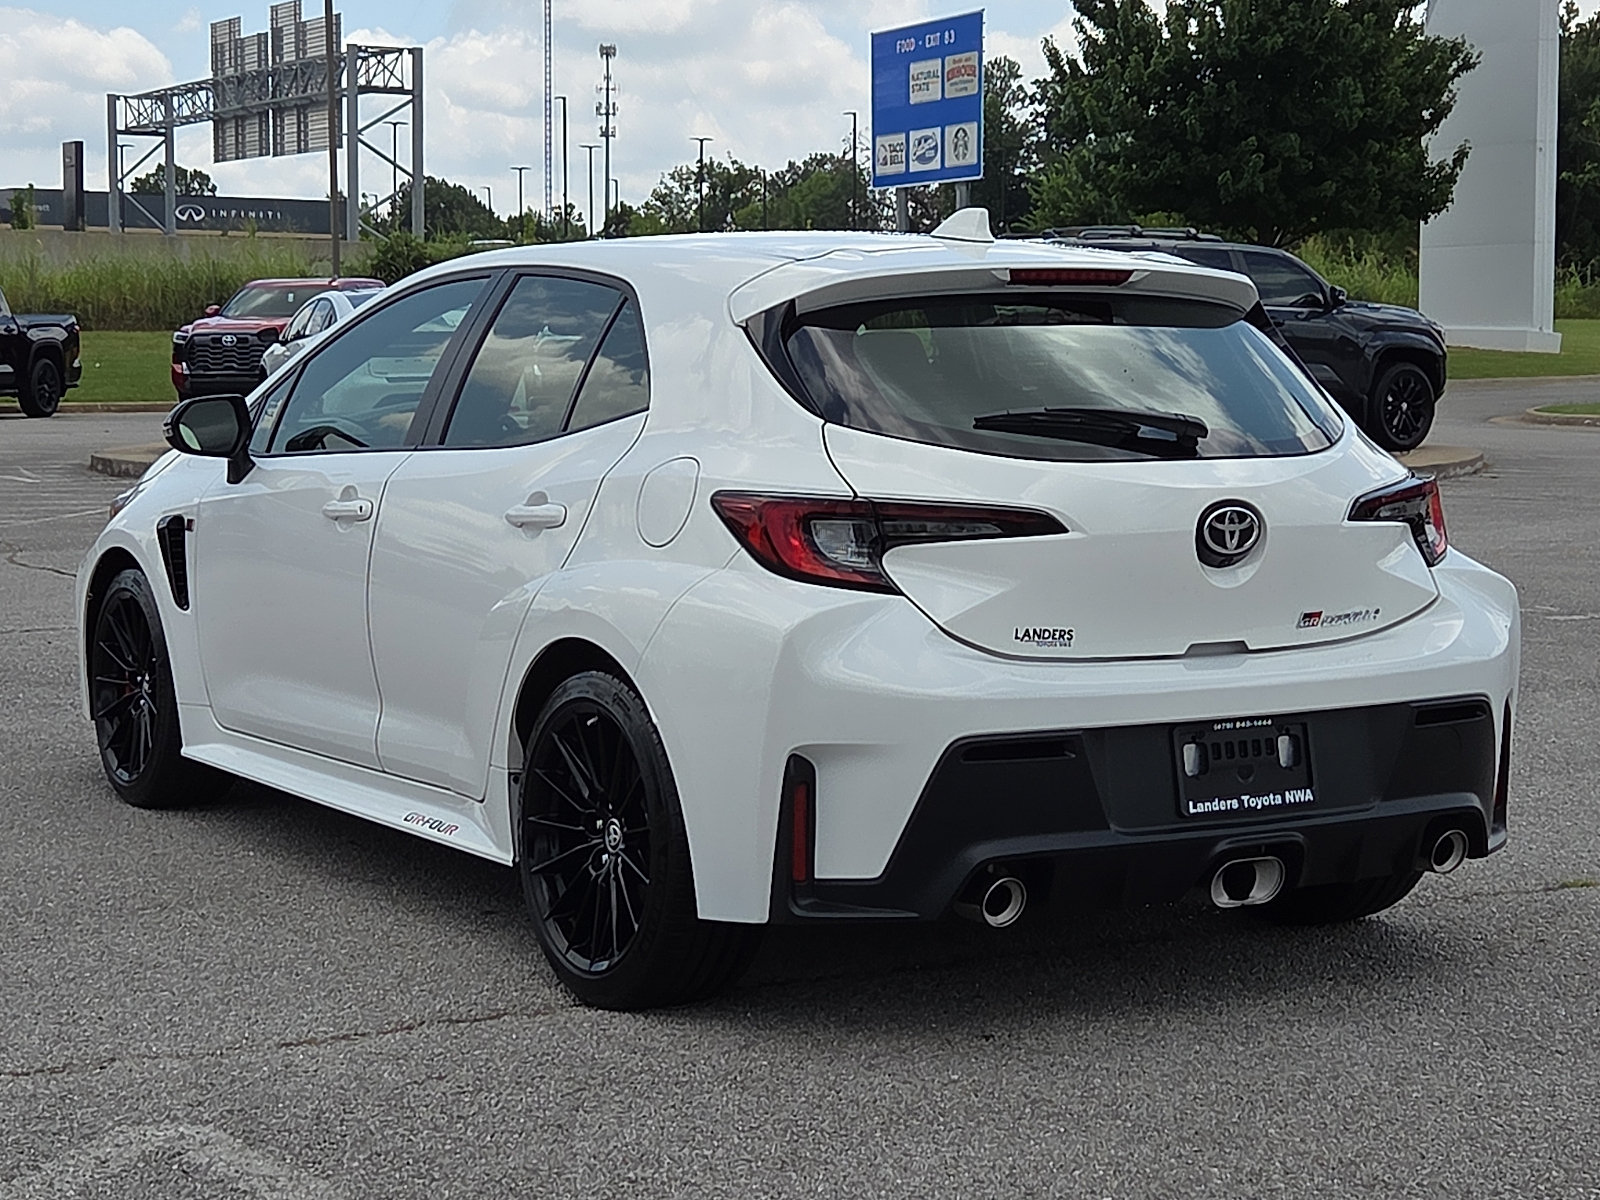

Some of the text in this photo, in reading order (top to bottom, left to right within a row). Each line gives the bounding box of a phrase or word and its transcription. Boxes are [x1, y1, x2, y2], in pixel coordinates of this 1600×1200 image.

[896, 37, 916, 54] FOOD
[925, 32, 941, 48] EXIT
[911, 69, 940, 82] NATURAL
[911, 82, 930, 94] STATE
[888, 141, 904, 153] TACO
[889, 153, 904, 166] BELL
[211, 208, 281, 220] INFINITI
[1014, 627, 1074, 643] LANDERS
[1188, 788, 1314, 814] Landers Toyota NWA
